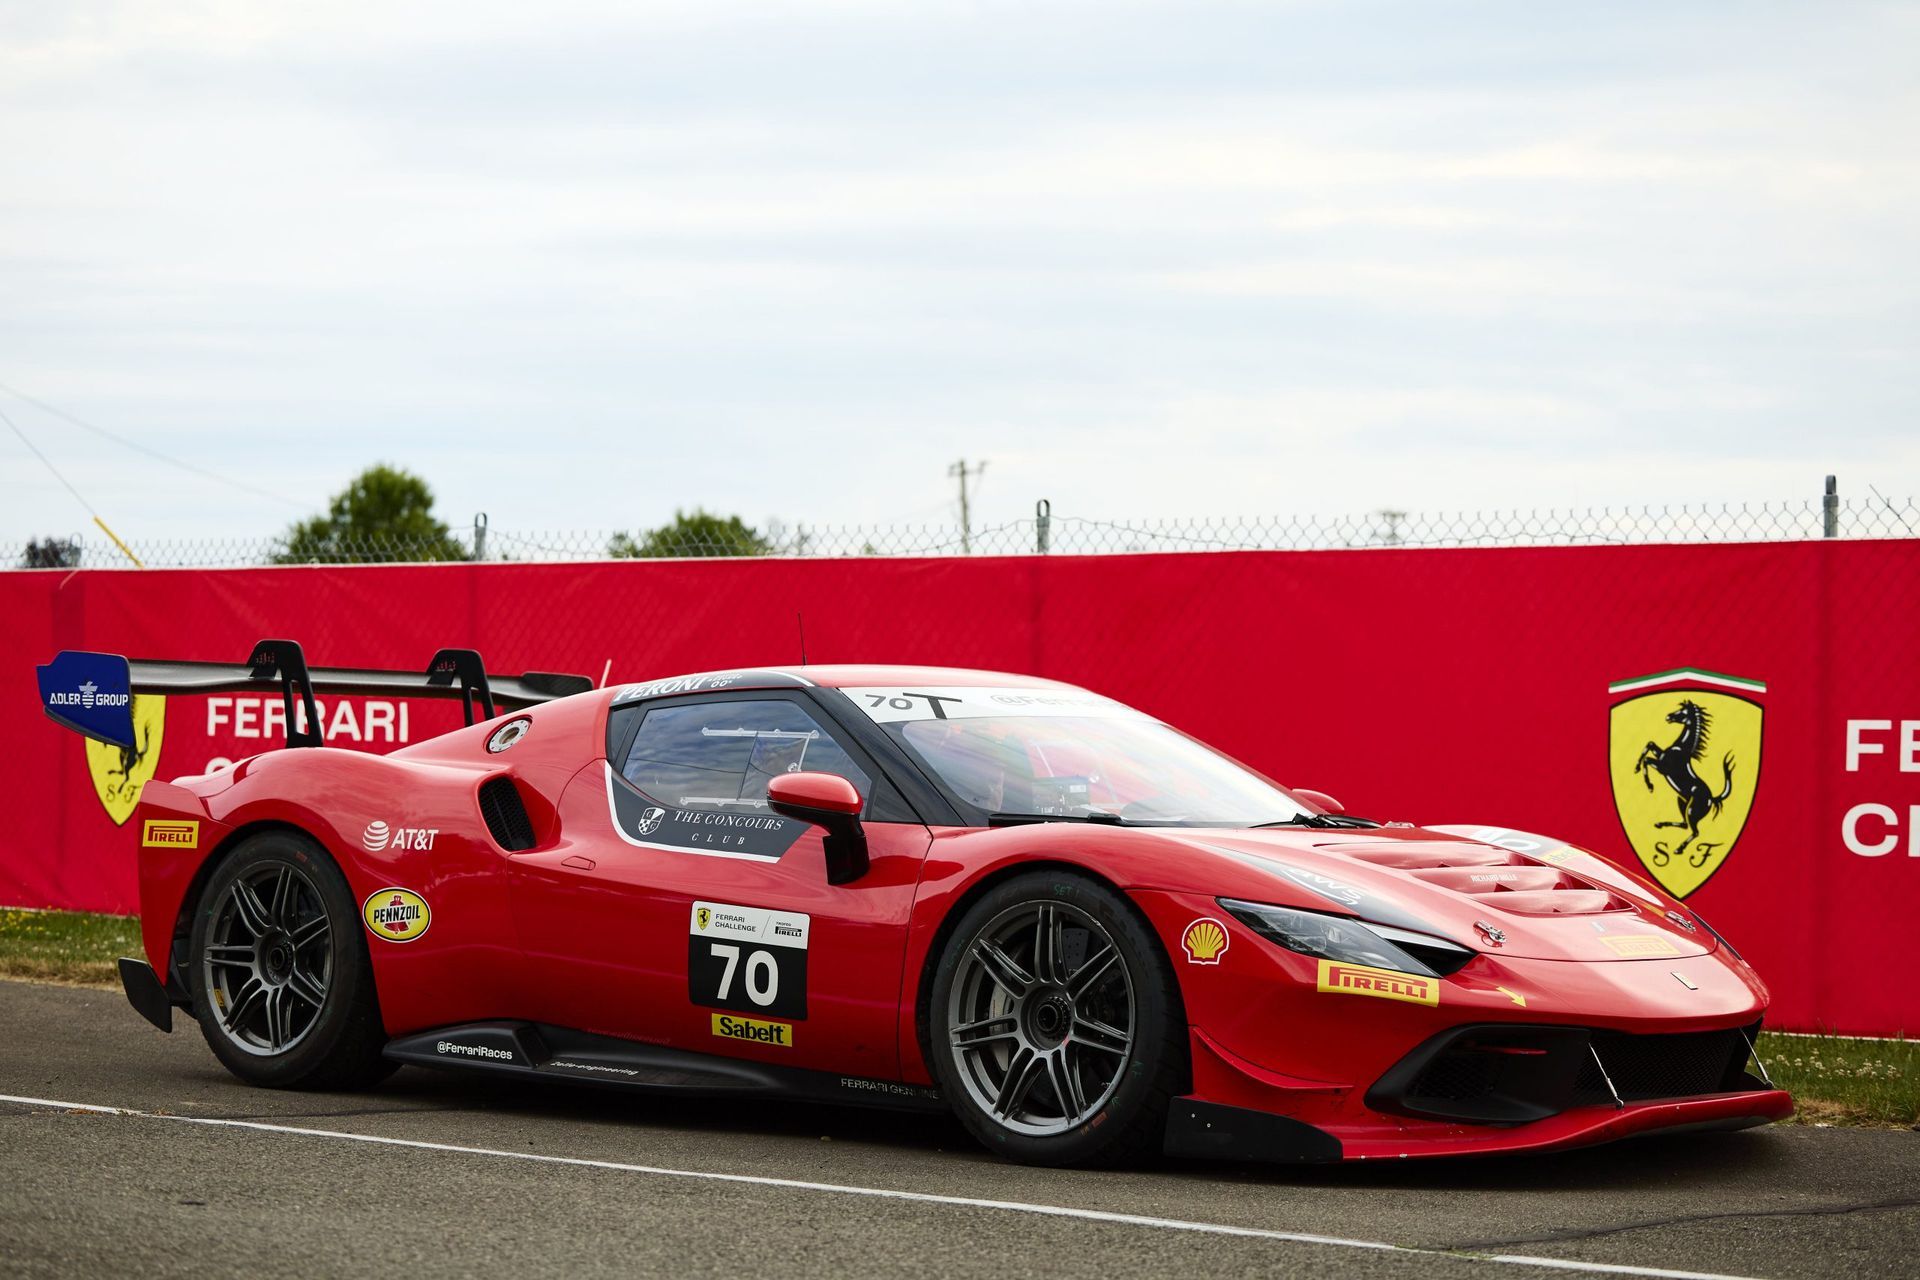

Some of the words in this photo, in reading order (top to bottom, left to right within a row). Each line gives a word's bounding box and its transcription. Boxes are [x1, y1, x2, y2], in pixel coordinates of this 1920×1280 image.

[49, 692, 81, 705] ADLER
[95, 693, 129, 706] GROUP
[613, 678, 706, 702] PERONI
[865, 694, 913, 710] 70
[903, 692, 962, 720] T
[673, 810, 704, 824] THE
[704, 813, 784, 831] CONCOURS
[147, 825, 194, 843] PIRELLI
[390, 828, 439, 851] AT&T
[1652, 841, 1670, 867] S
[1688, 842, 1724, 868] F
[373, 905, 421, 924] PENNZOIL
[715, 913, 746, 923] FERRARI
[715, 921, 757, 933] CHALLENGE
[774, 926, 803, 938] PIRELLI
[710, 943, 779, 1007] 70
[1328, 966, 1429, 1000] PIRELLI
[719, 1016, 785, 1044] Sabelt
[436, 1041, 513, 1061] @FerrariRaces
[840, 1078, 888, 1093] FERRARI
